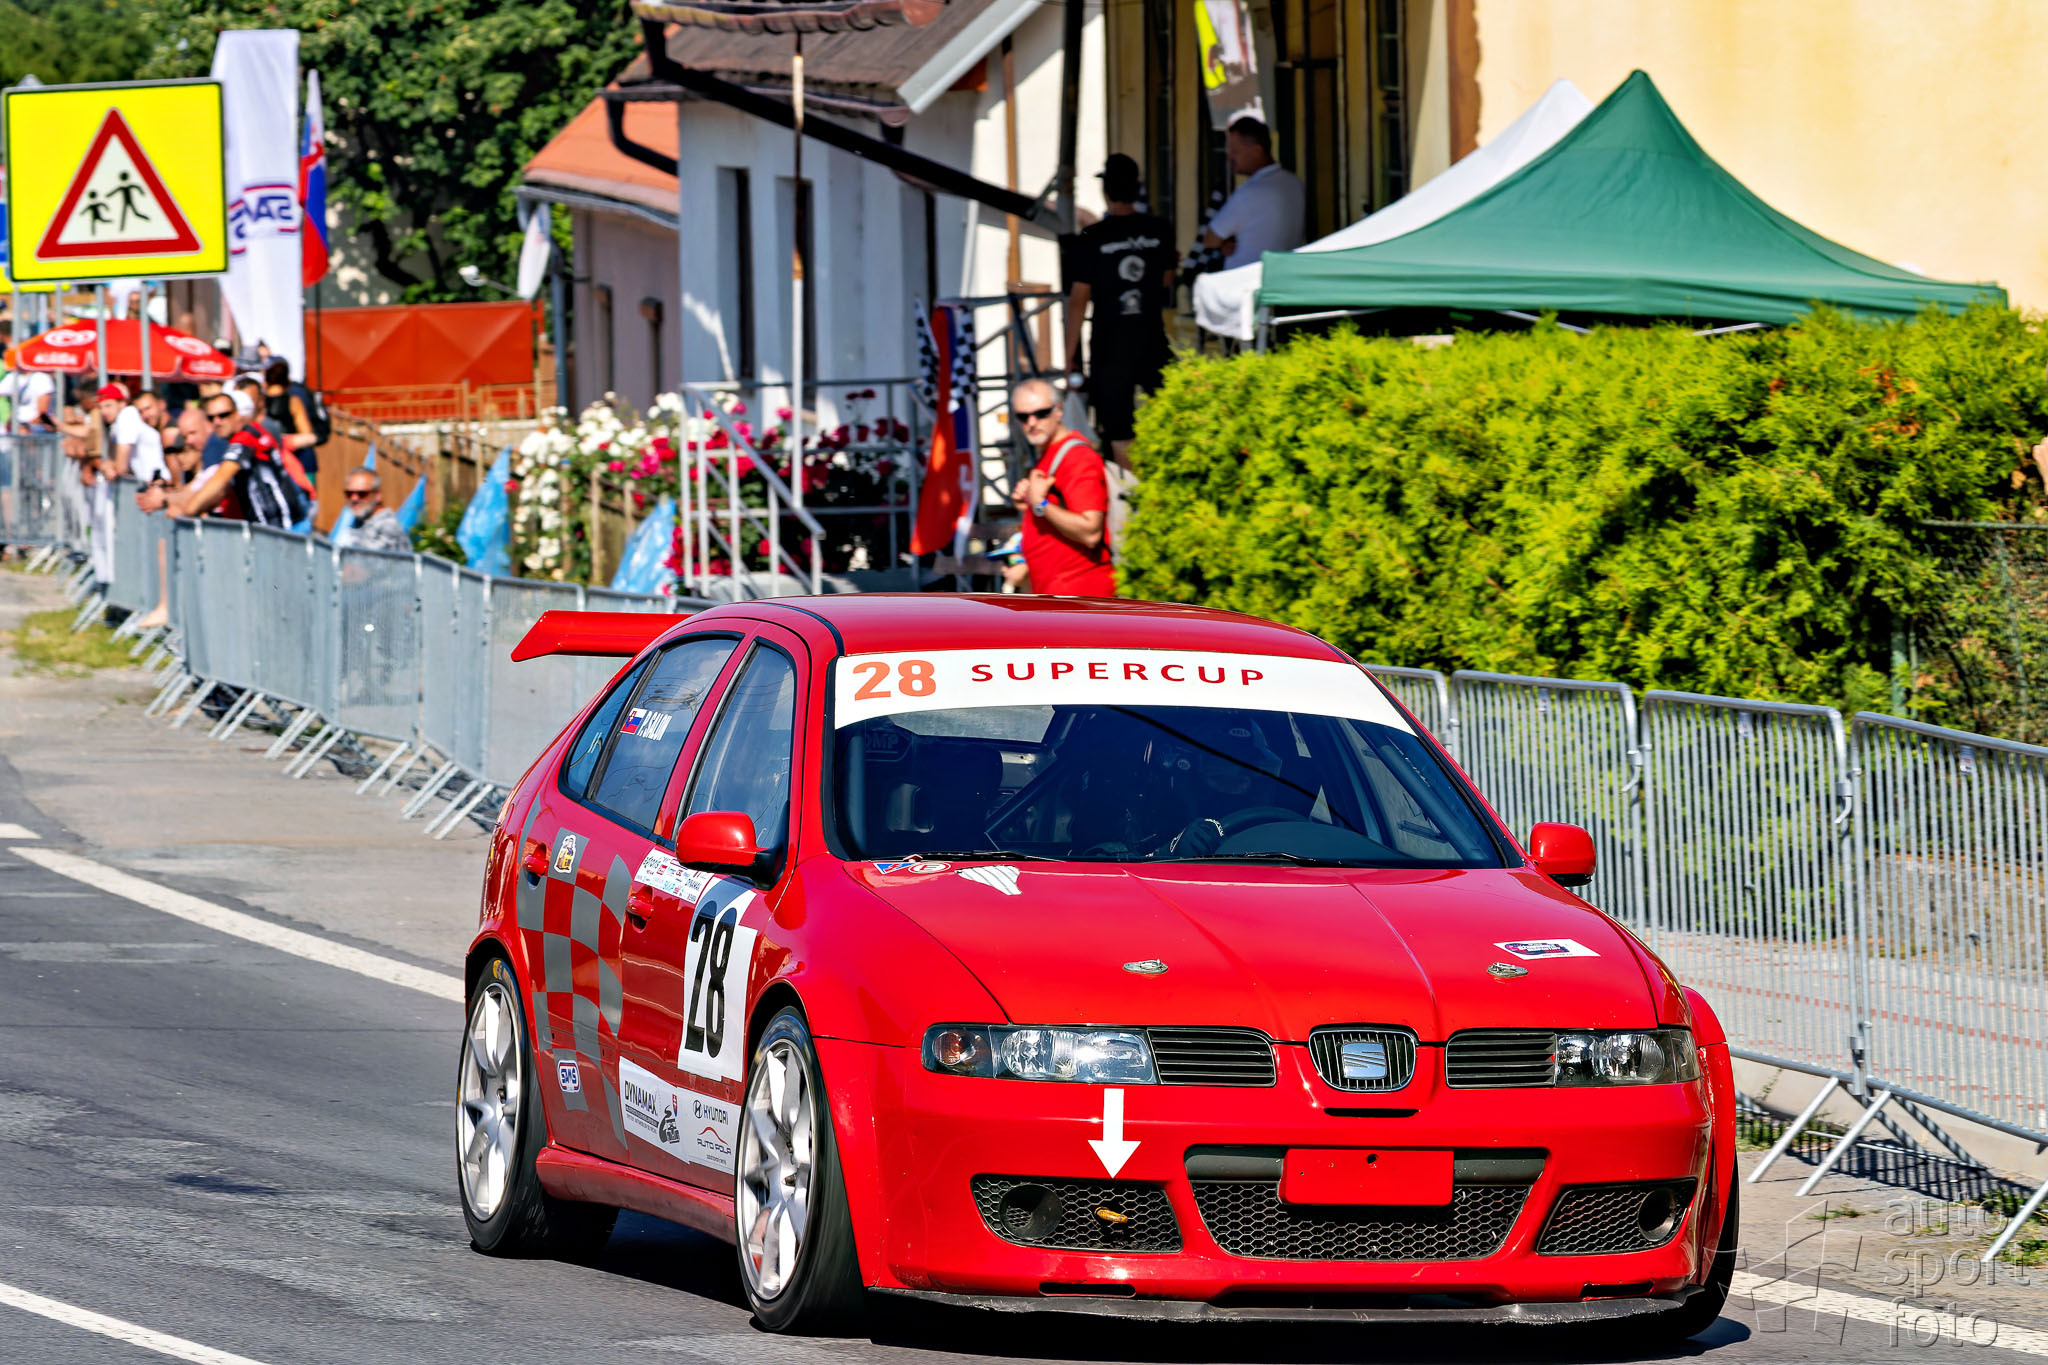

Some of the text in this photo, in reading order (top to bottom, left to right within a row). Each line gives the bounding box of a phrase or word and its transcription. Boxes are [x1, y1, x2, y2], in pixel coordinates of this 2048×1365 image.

[852, 659, 937, 701] 28
[971, 662, 1264, 686] SUPERCUP
[684, 900, 738, 1058] 28
[624, 1079, 659, 1117] DYNAMAX
[703, 1104, 729, 1126] HYUNDAI
[696, 1138, 714, 1150] AUTO
